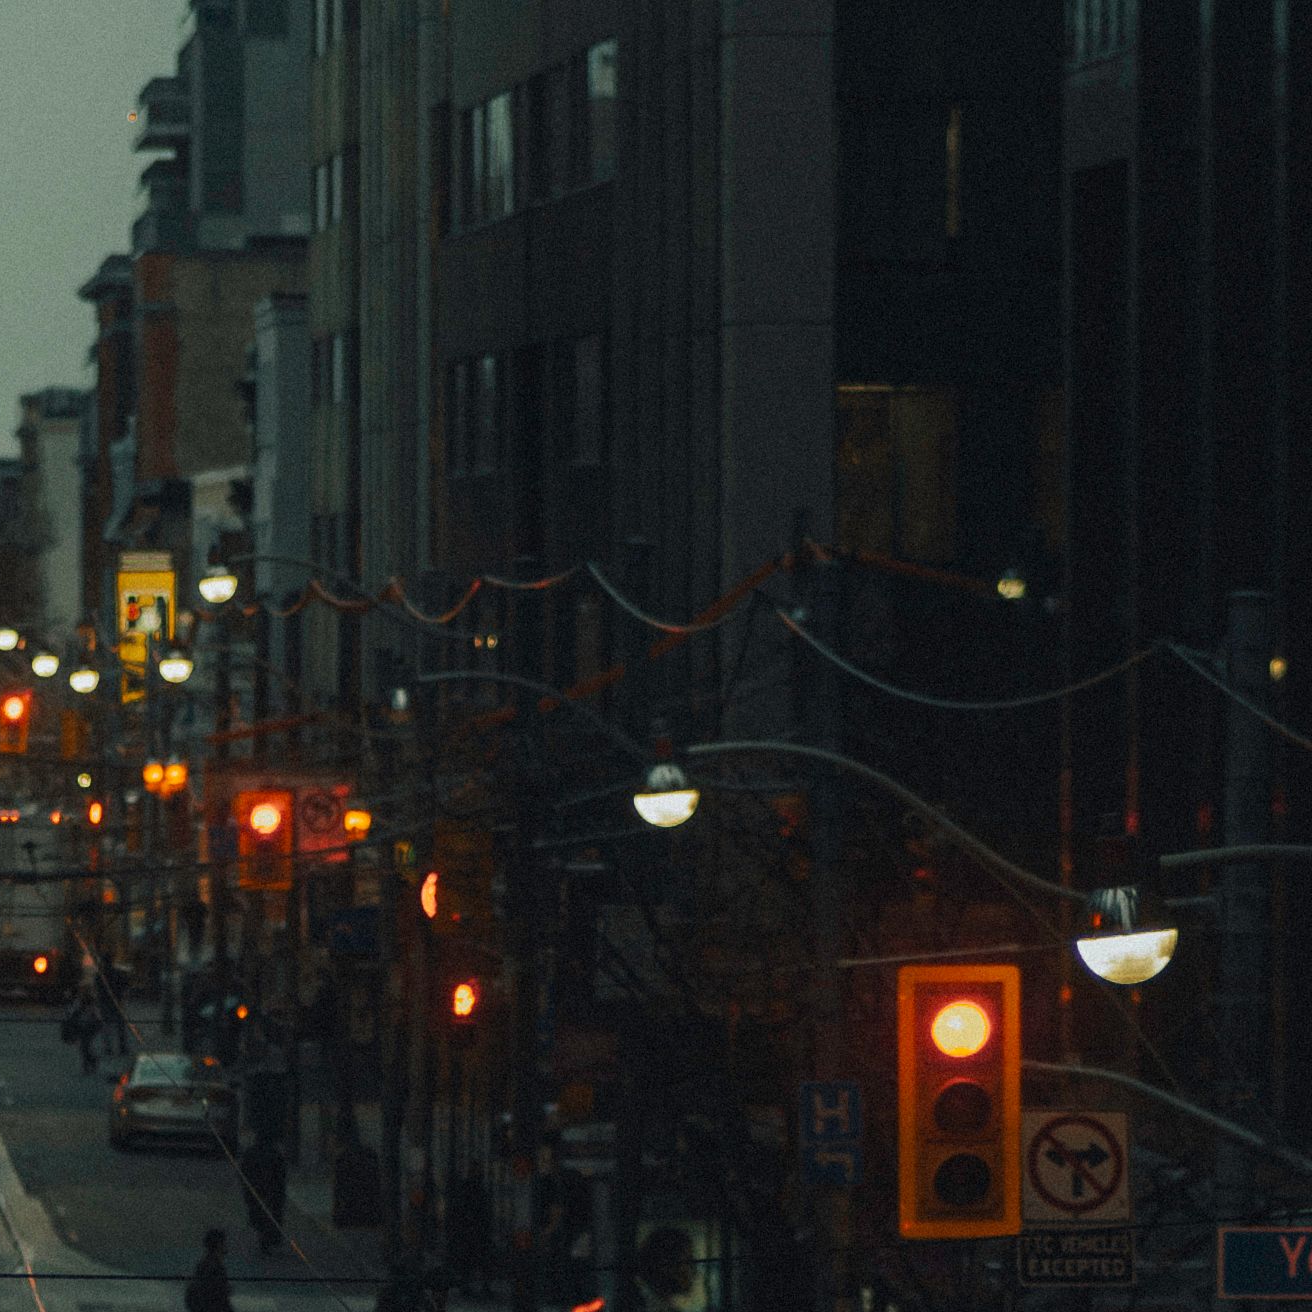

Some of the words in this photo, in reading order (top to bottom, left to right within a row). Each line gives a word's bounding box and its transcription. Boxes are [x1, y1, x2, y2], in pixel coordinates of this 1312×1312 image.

[813, 1087, 850, 1134] H
[1060, 1235, 1130, 1255] VEHICLES
[1279, 1235, 1312, 1278] Y
[1027, 1257, 1126, 1278] EXCEPTED
